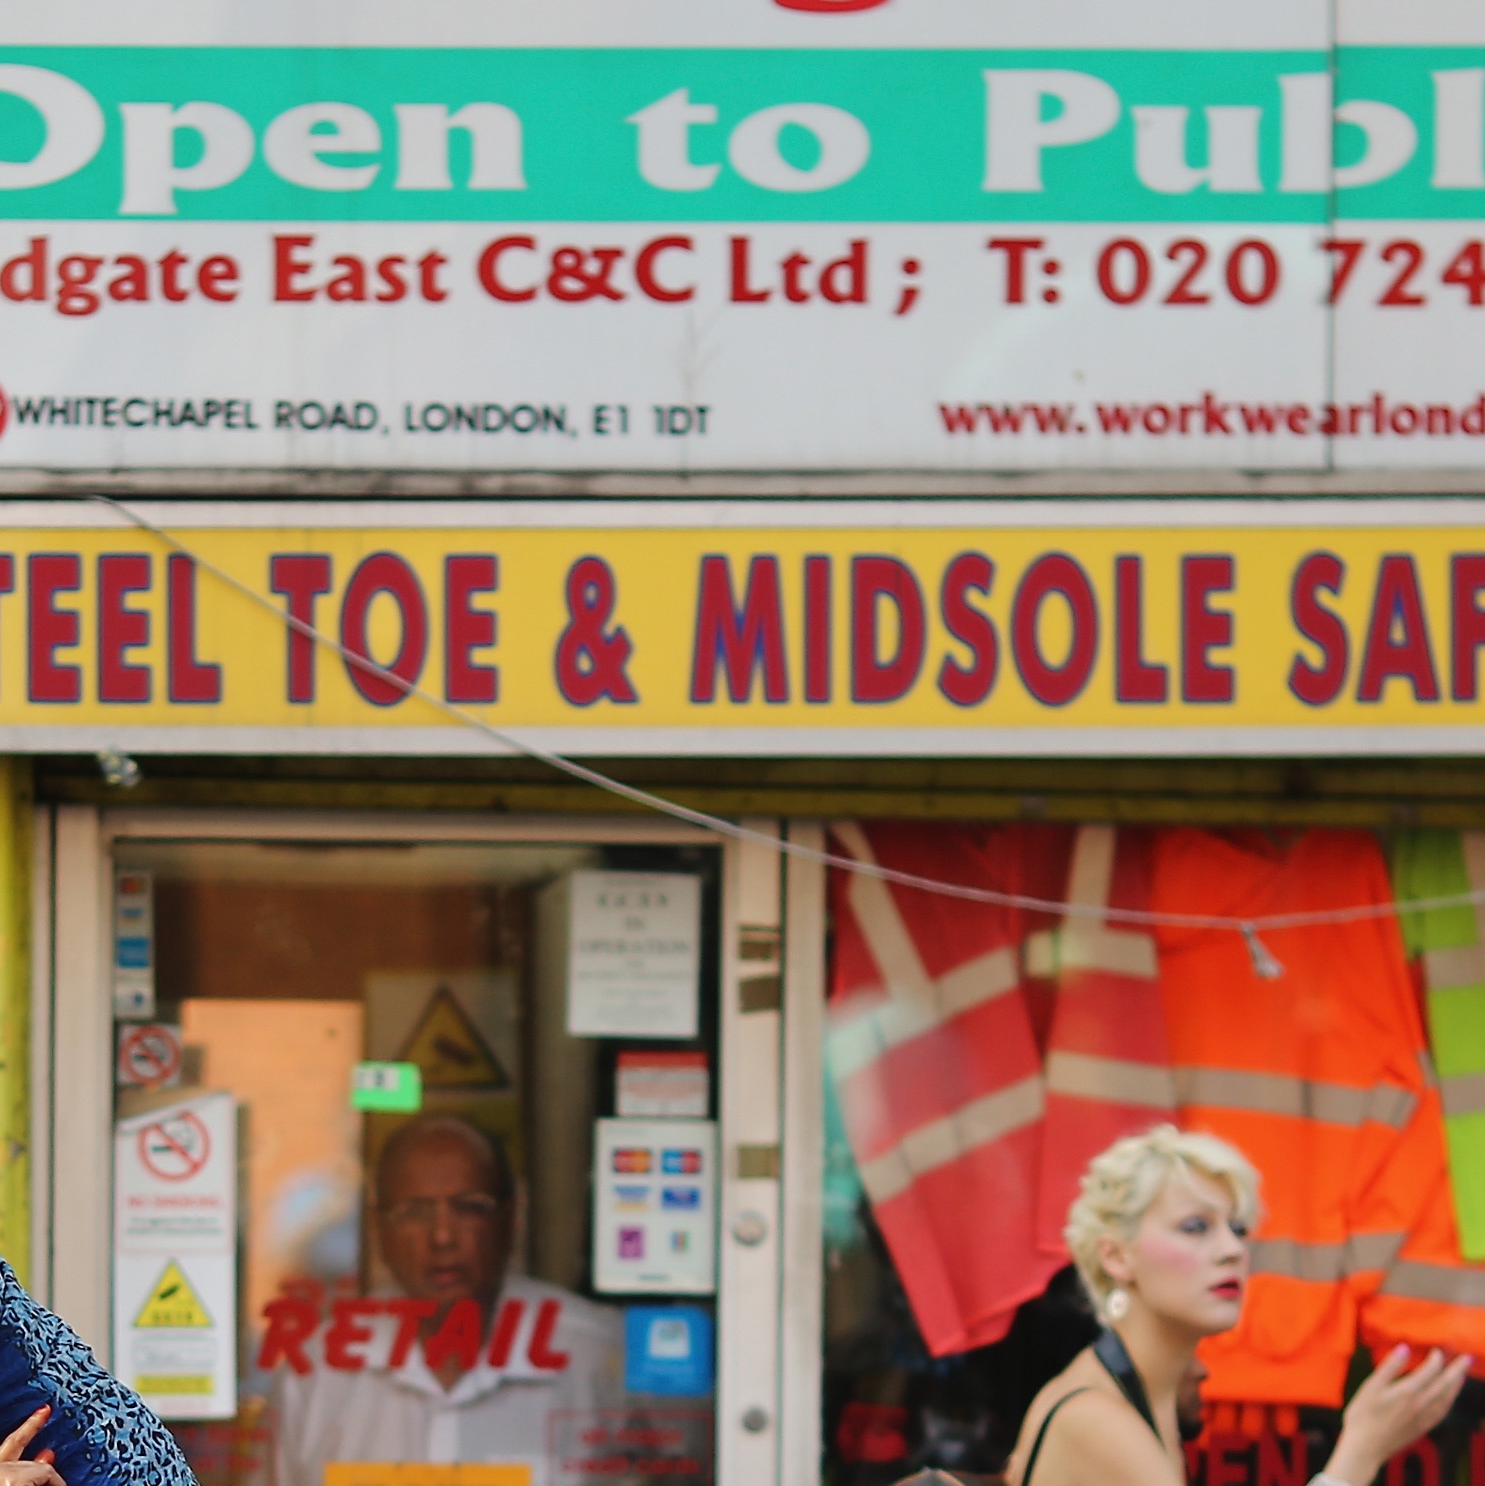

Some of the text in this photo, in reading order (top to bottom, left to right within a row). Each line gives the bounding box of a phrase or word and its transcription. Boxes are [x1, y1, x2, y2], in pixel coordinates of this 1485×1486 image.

[624, 86, 872, 193] to
[271, 233, 449, 306] East
[475, 233, 697, 306] C&C
[727, 234, 870, 306] Ltd
[986, 236, 1062, 306] T:
[1095, 236, 1282, 308] 020
[13, 394, 257, 431] WHITECHAPEL
[274, 399, 390, 436] ROAD,
[405, 401, 578, 437] LONDON,
[593, 403, 628, 436] E1
[654, 403, 710, 437] 1DT
[268, 550, 500, 709] TOE
[552, 554, 640, 709] &
[688, 550, 1237, 709] MIDSOLE
[256, 1298, 571, 1377] RETAIL
